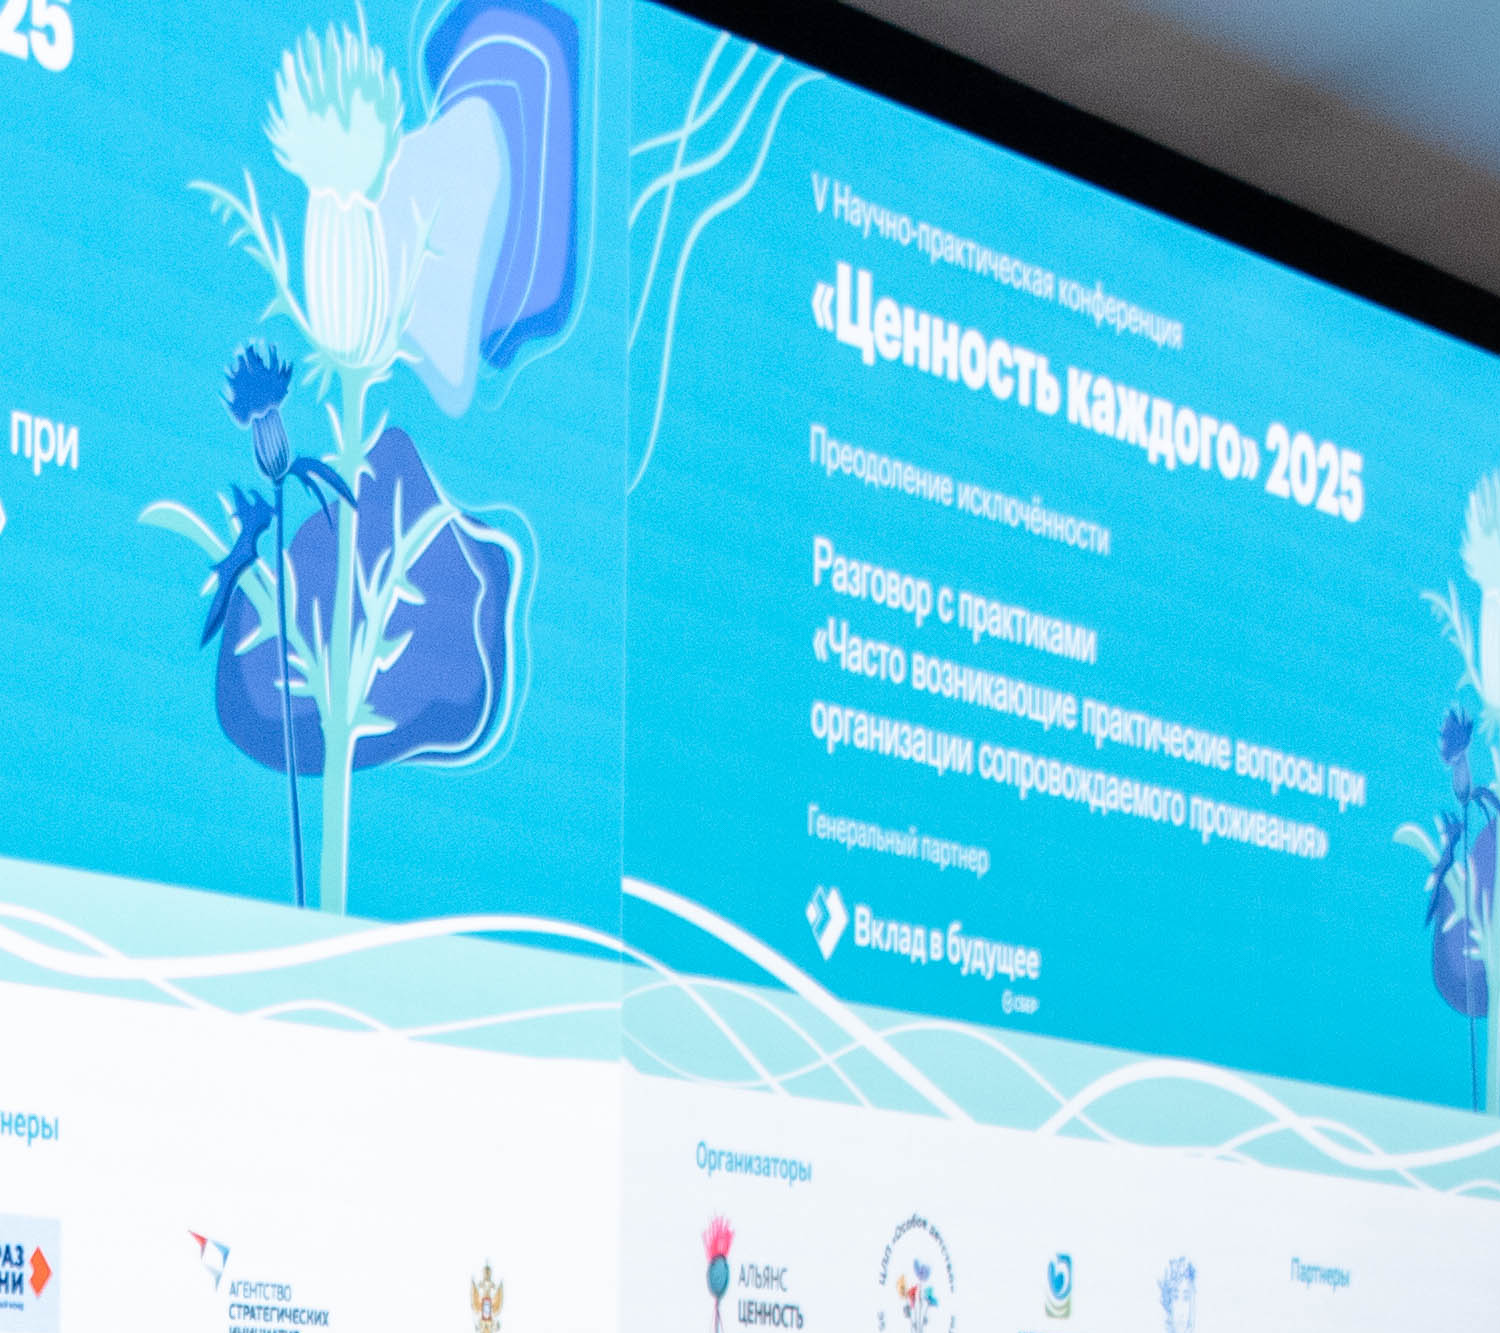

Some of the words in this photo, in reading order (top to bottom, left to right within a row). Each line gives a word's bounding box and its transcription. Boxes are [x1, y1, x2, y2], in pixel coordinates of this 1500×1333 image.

[811, 172, 829, 213] V
[833, 183, 1054, 302] Научно-практическая
[1059, 280, 1183, 349] конференция
[811, 262, 1061, 418] «Ценность
[1067, 364, 1258, 480] каждого»
[1266, 422, 1364, 523] 2025
[11, 413, 79, 471] при
[811, 424, 953, 510] Преодоление
[957, 477, 1111, 556] исключённости
[812, 536, 930, 626] Разговор
[937, 586, 954, 624] с
[959, 591, 1097, 664] практиками
[812, 617, 905, 684] «Часто
[912, 653, 1076, 731] возникающие
[1082, 695, 1230, 771] практические
[1236, 737, 1324, 797] вопросы
[1328, 762, 1366, 811] при
[811, 700, 973, 777] организации
[979, 739, 1184, 826] сопровождаемого
[1191, 794, 1327, 859] проживания»
[807, 804, 917, 856] Генеральный
[921, 834, 989, 878] партнер
[855, 906, 925, 961] Вклад
[929, 931, 943, 959] в
[947, 923, 1041, 981] будущее
[696, 1142, 812, 1186] Организаторы
[229, 1280, 292, 1301] АГЕНТСТВО
[738, 1264, 787, 1293] АЛЬЯНС
[1291, 1257, 1350, 1293] Партнеры
[229, 1303, 329, 1326] СТРАТЕГИЧЕСКИХ
[738, 1300, 803, 1329] ЦЕННОСТЬ
